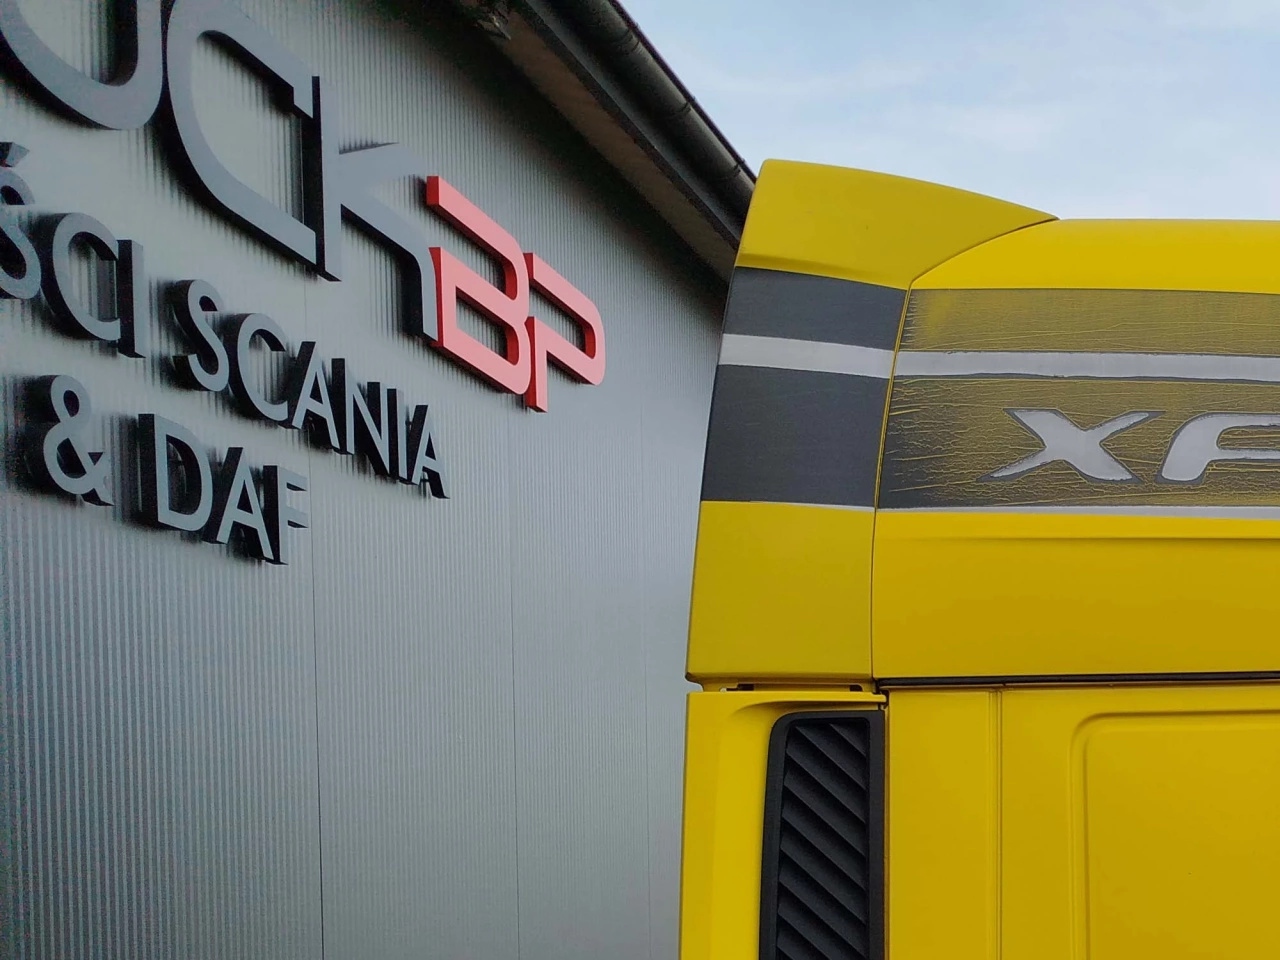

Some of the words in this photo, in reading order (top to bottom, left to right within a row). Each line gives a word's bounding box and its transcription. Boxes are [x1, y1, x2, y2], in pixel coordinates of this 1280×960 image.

[43, 374, 114, 507] &
[143, 413, 309, 565] DAF
[177, 279, 450, 499] SCANIA
